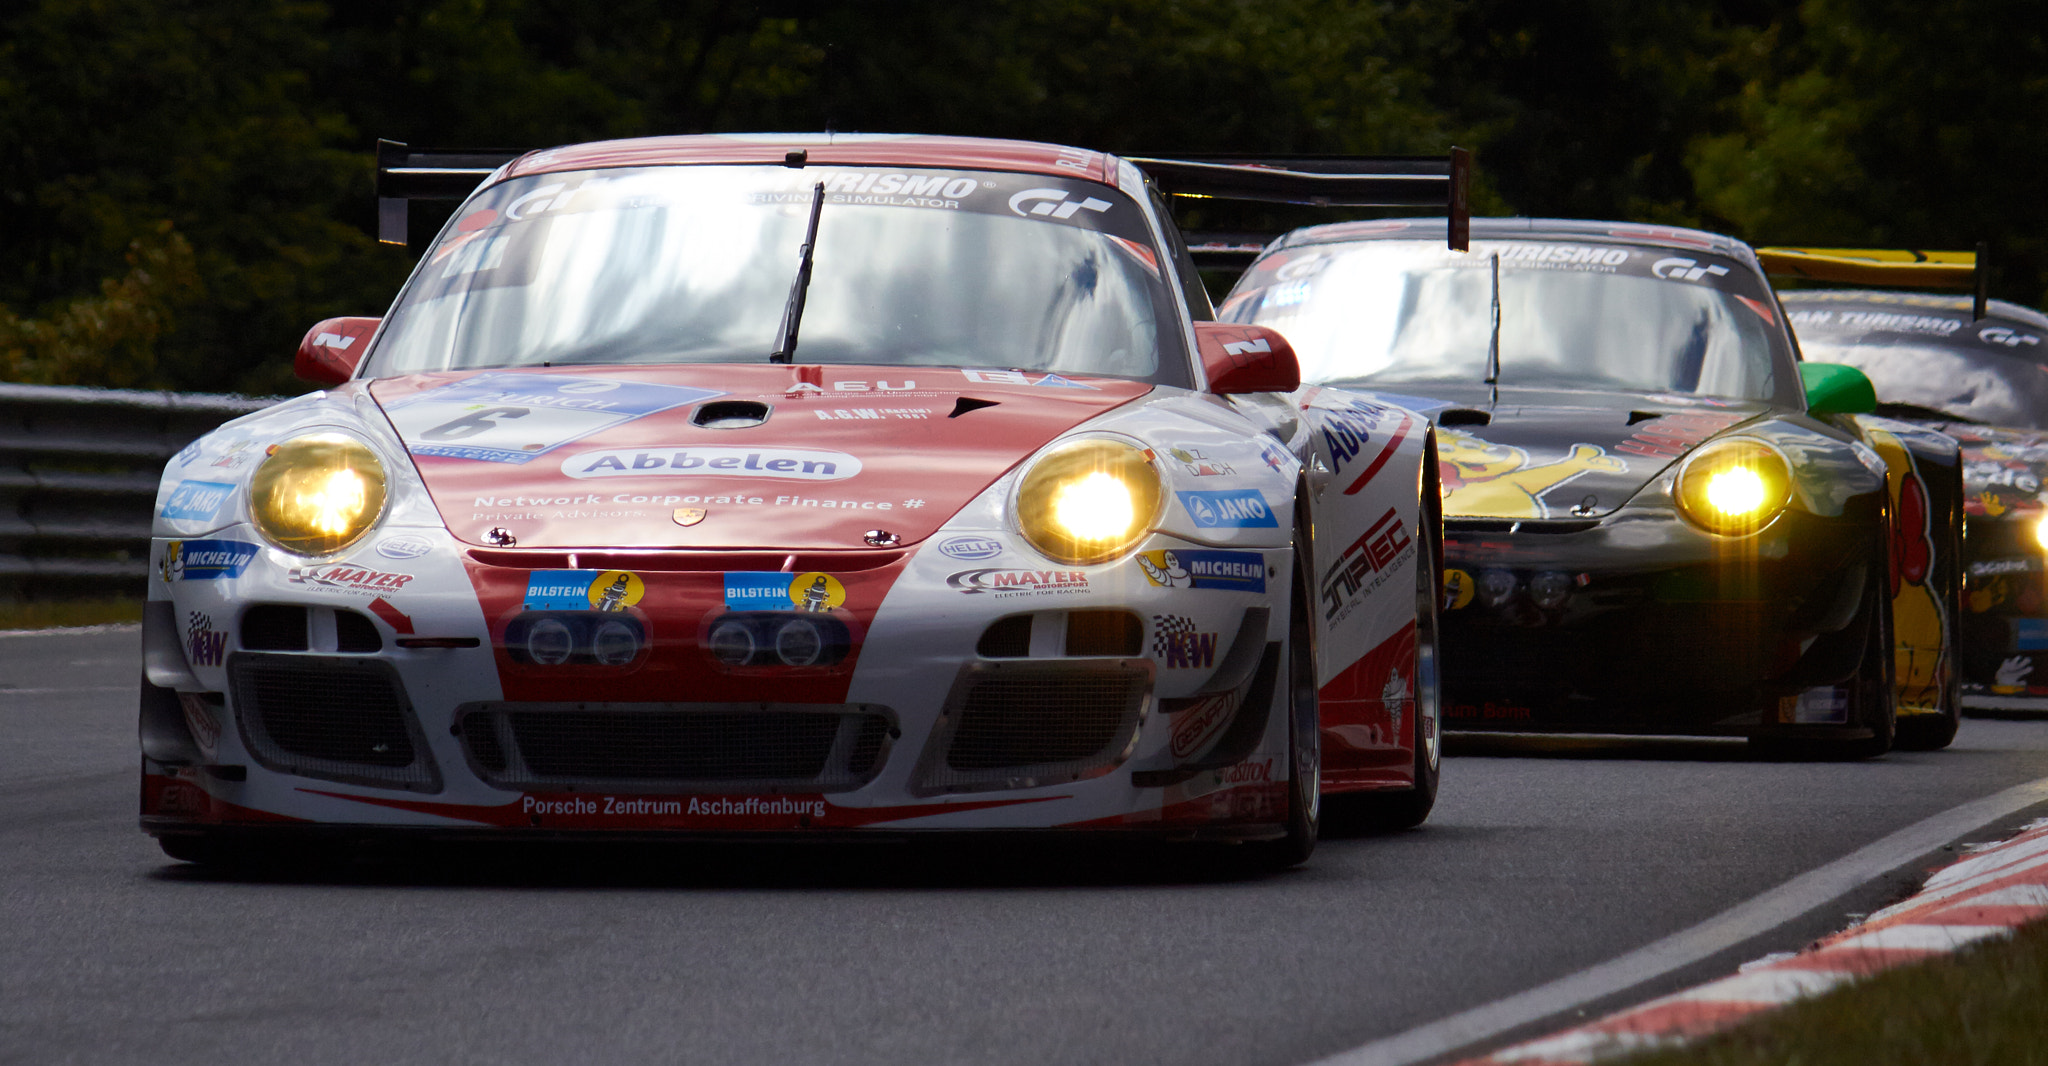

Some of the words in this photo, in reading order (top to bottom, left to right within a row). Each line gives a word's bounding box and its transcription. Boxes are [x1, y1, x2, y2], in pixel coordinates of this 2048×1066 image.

[832, 194, 959, 209] SIMULATOR
[1477, 244, 1629, 266] TURISMO
[1839, 311, 1962, 333] TURISMO
[785, 380, 917, 393] AEU
[813, 408, 886, 420] A.G.W.
[419, 407, 531, 441] 6
[583, 452, 837, 476] Abbelen
[183, 491, 223, 512] JAKO
[473, 494, 601, 508] Network
[612, 492, 763, 507] Corporate
[775, 495, 892, 510] Finance
[1215, 498, 1266, 520] JAKO
[472, 511, 543, 521] Private
[944, 539, 1003, 553] HELLA
[186, 551, 252, 567] MICHELIN
[321, 567, 414, 588] MAYER
[993, 570, 1088, 587] MAYER
[1191, 560, 1263, 579] MICHELIN
[1362, 545, 1417, 599] INTELLIGENCE
[349, 583, 400, 593] MOTORSPORT
[527, 586, 586, 598] BILSTEIN
[726, 586, 787, 599] BILSTEIN
[1033, 582, 1089, 590] MOTORSPORT
[193, 631, 228, 667] KW
[1166, 632, 1218, 669] KW
[523, 796, 597, 814] Porsche
[603, 797, 681, 814] Zentrum
[687, 798, 826, 817] Aschaffenburg
